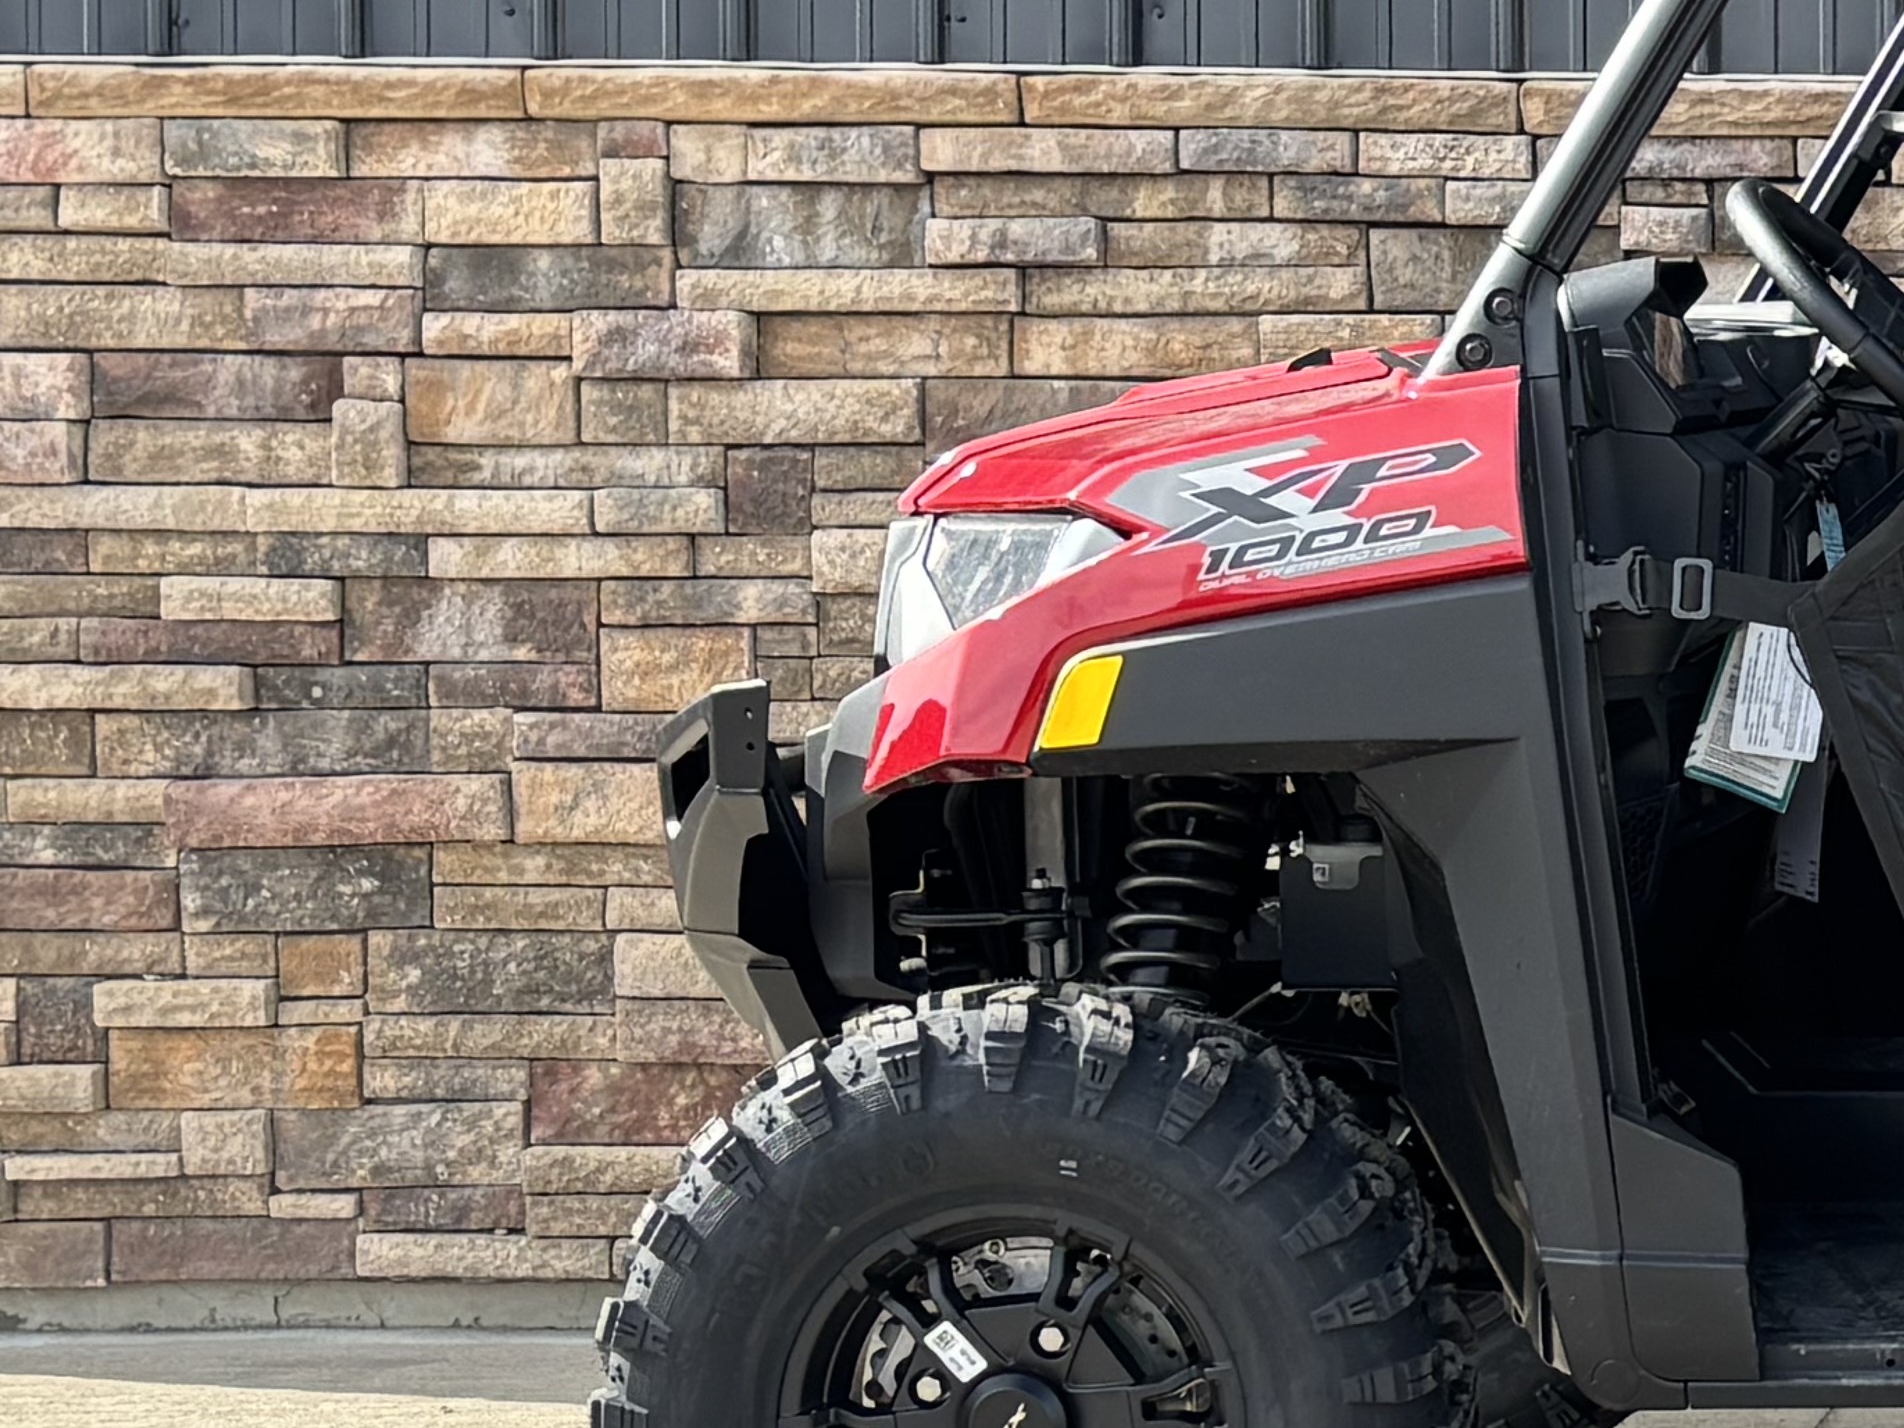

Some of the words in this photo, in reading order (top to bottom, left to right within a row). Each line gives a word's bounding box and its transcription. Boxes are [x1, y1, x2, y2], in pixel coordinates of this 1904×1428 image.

[1134, 439, 1482, 555] XP
[1198, 574, 1252, 592] DUAL
[1256, 549, 1368, 580] OVERHEAD
[1370, 541, 1423, 561] CAM
[1200, 506, 1437, 578] 1000
